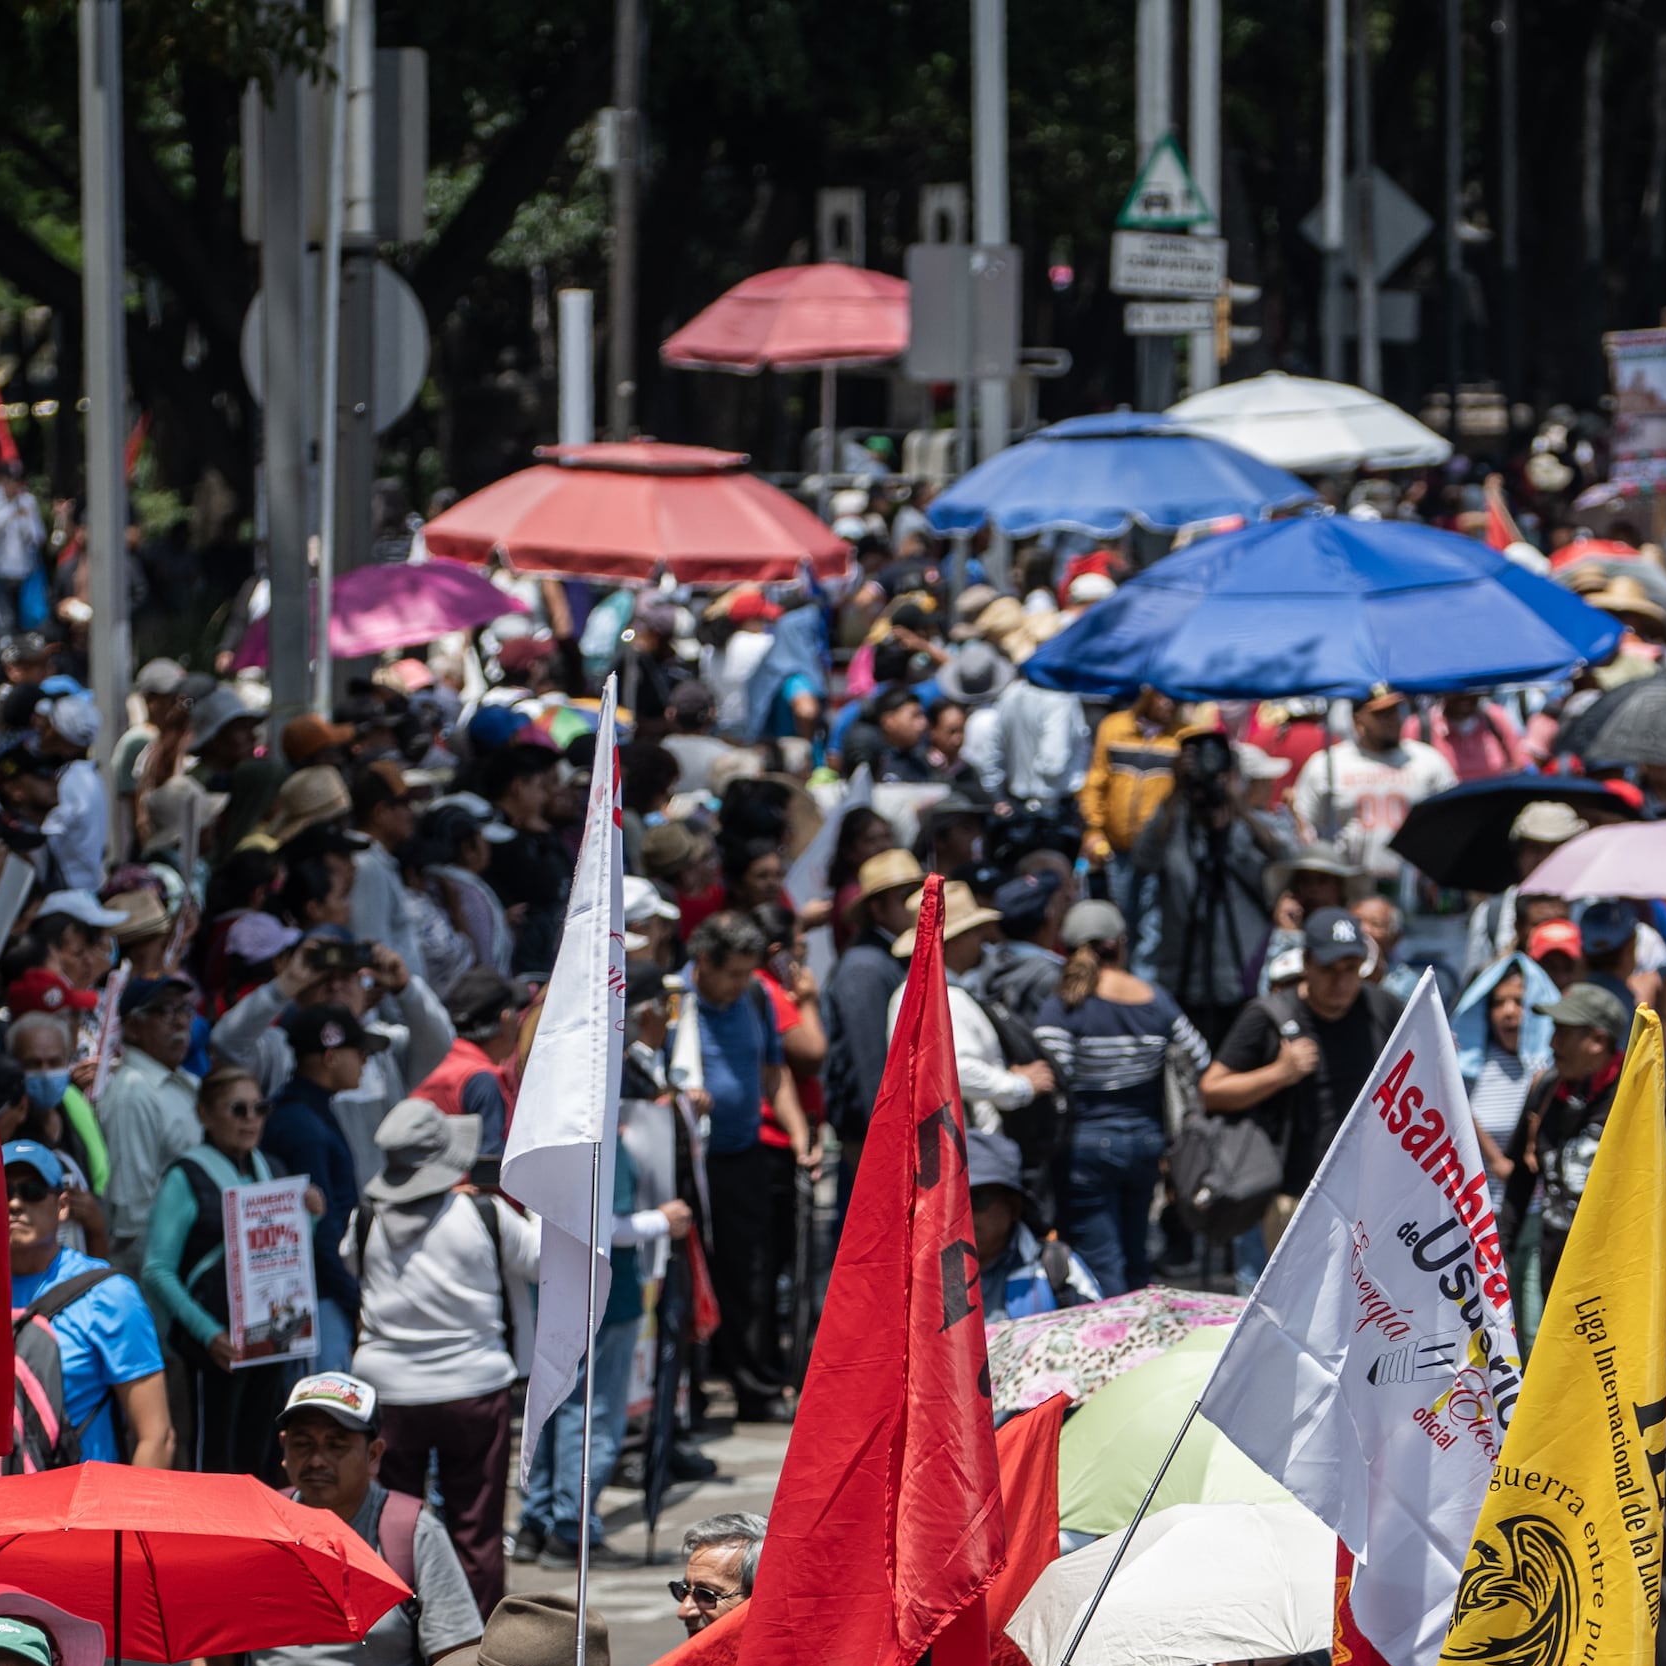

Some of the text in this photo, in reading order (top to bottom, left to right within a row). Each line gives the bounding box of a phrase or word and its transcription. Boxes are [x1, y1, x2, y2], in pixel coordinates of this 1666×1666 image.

[1371, 1049, 1511, 1311] Asamblea
[1397, 1219, 1420, 1248] de
[1573, 1295, 1607, 1345] Liga
[1412, 1406, 1458, 1452] oficial
[1592, 1344, 1636, 1501] Internacional
[1621, 1487, 1646, 1532] de
[1489, 1464, 1584, 1518] guerra
[1583, 1520, 1606, 1610] entre
[1630, 1530, 1660, 1559] la
